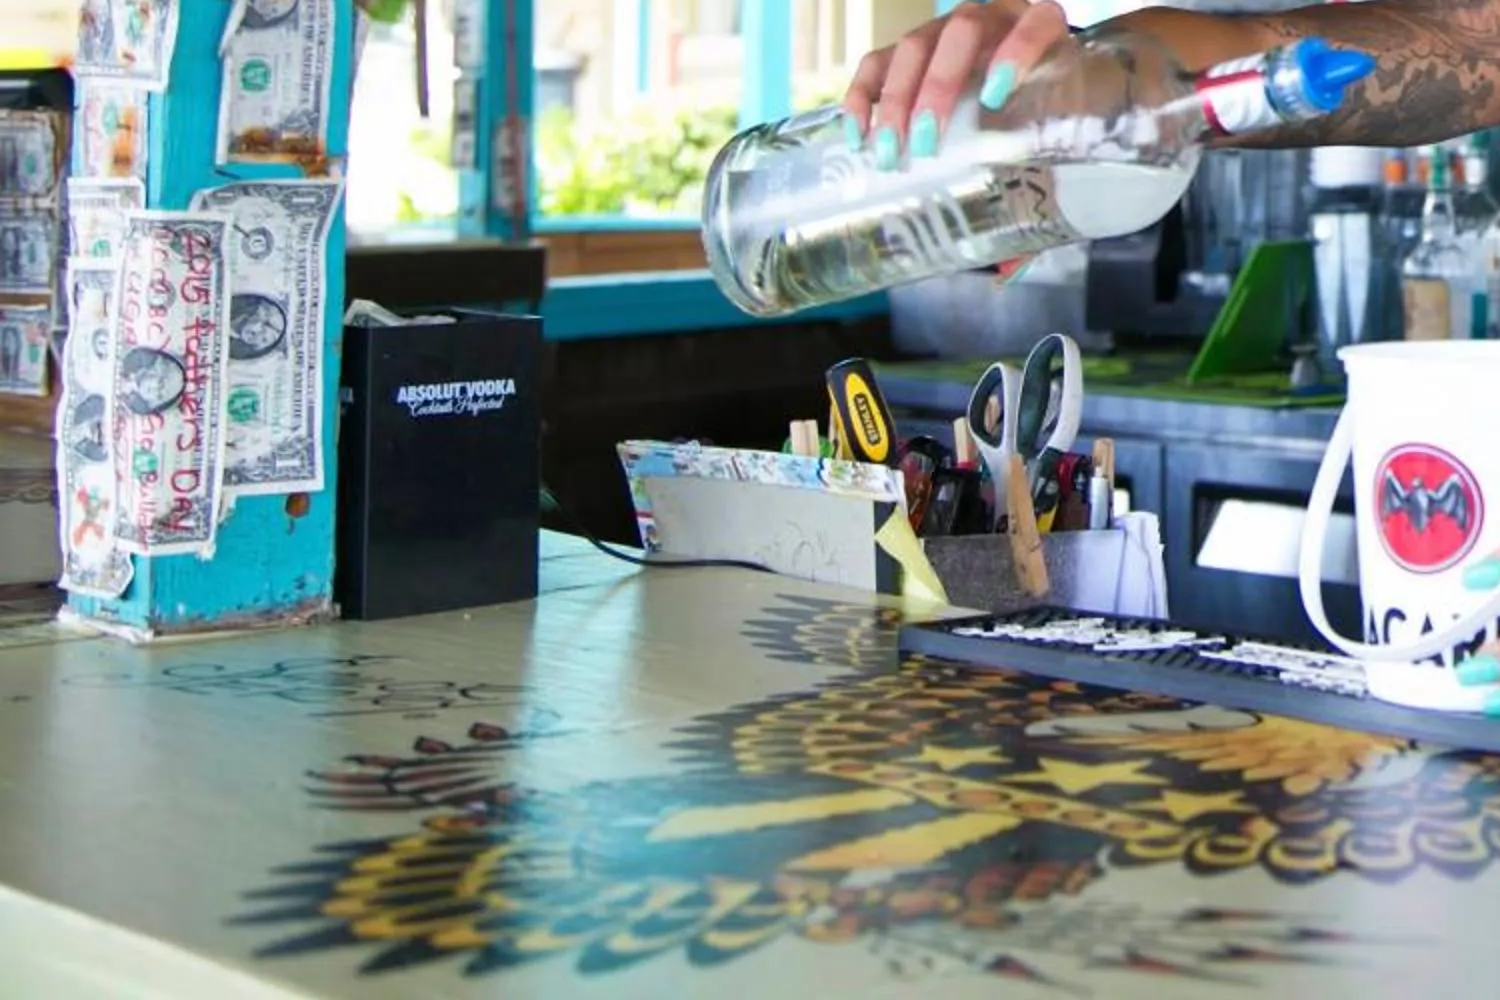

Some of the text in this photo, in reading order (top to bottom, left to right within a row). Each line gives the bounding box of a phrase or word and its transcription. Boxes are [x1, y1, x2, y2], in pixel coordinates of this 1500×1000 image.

[397, 378, 516, 403] ABSOLUT VODKA
[855, 396, 880, 443] STANLEY
